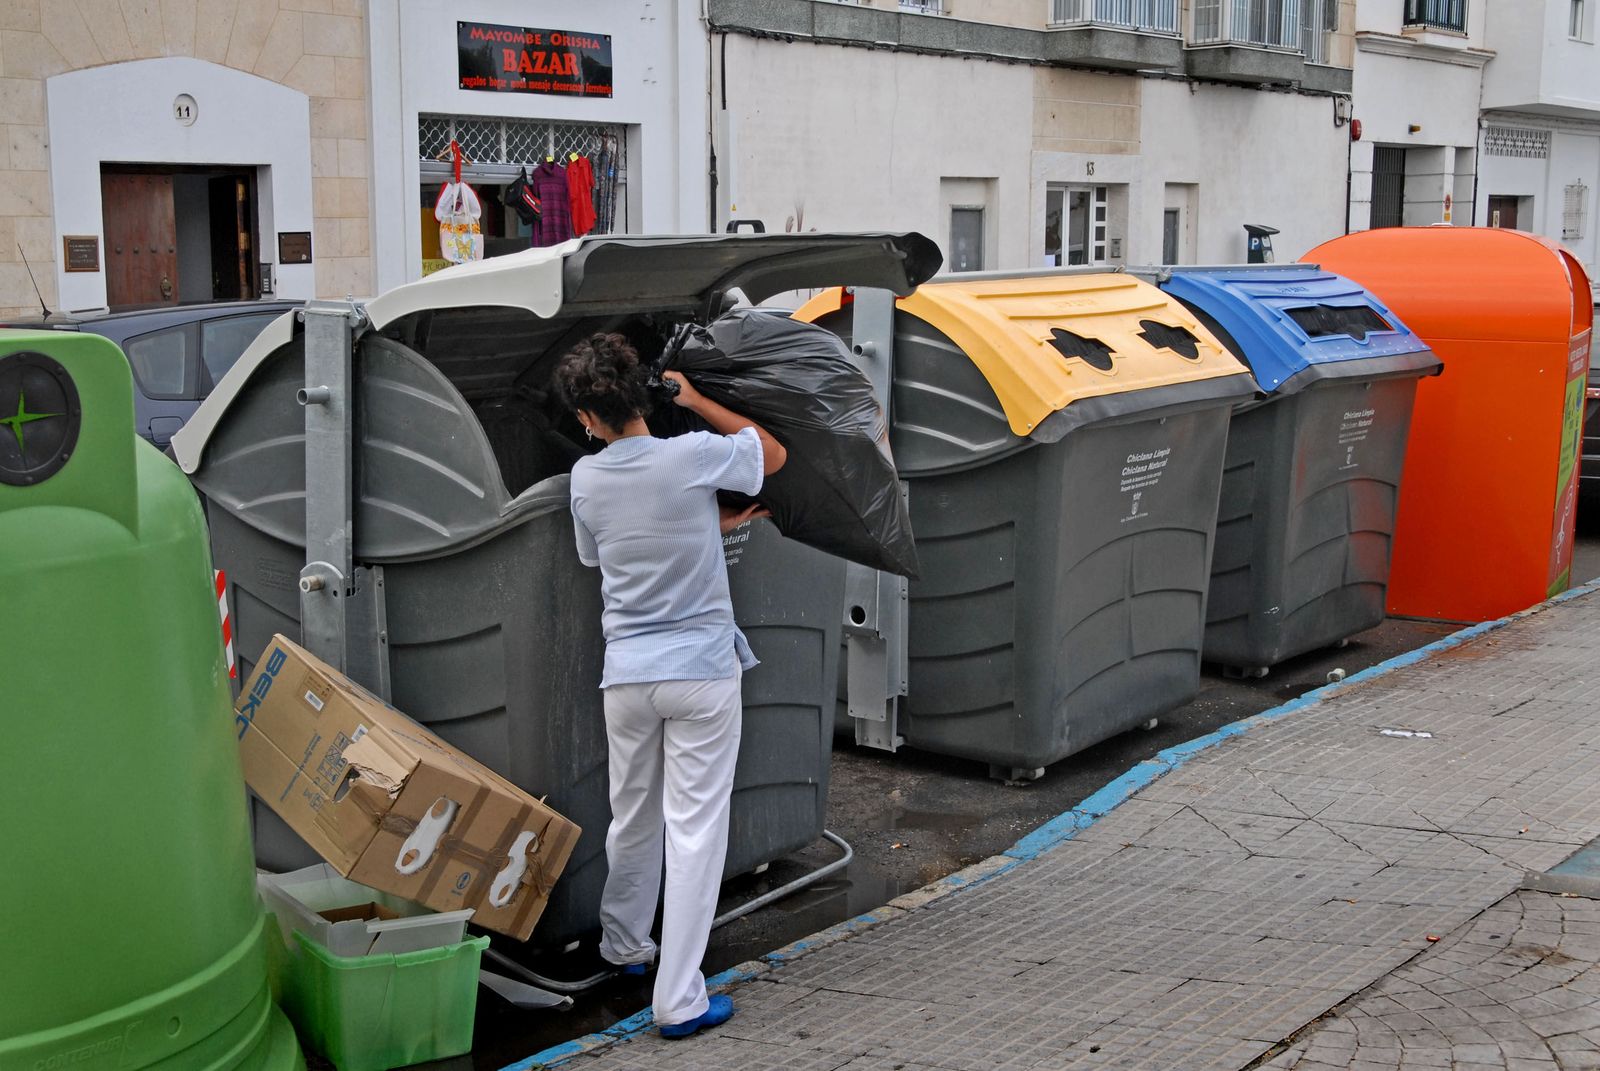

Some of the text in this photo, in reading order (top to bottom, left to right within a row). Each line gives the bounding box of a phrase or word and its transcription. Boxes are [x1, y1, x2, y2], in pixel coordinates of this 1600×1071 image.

[470, 27, 600, 50] MAYOMBE ORISHA
[503, 48, 579, 76] BAZAR
[176, 105, 190, 118] 11
[1086, 161, 1095, 176] 13
[1251, 237, 1260, 250] P
[722, 531, 750, 545] atural
